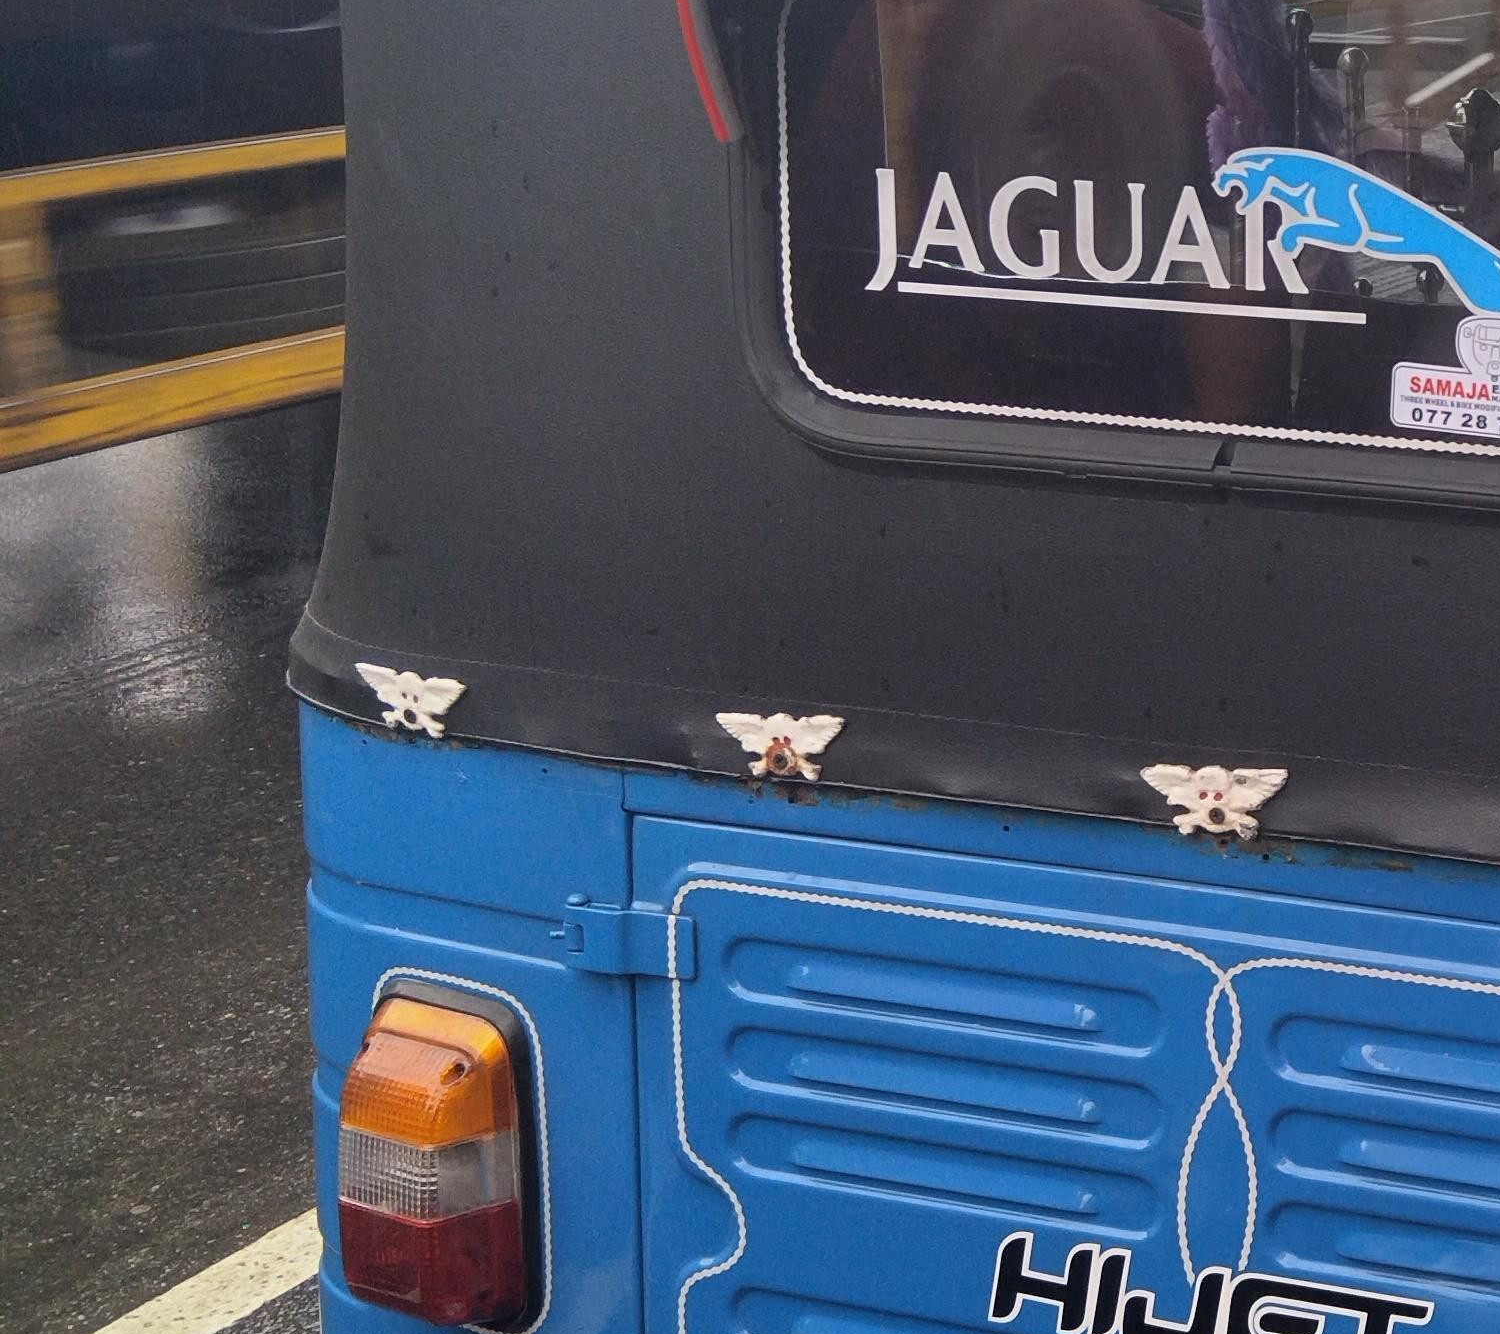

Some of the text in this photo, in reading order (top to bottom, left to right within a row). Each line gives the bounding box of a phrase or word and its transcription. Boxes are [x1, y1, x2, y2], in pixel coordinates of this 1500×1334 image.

[864, 168, 1310, 295] JAGUAR
[1410, 376, 1491, 401] SAMAJA
[1400, 395, 1423, 404] THREE
[1425, 397, 1450, 407] WHEEL
[1456, 401, 1473, 409] BIKE
[1412, 407, 1452, 425] 077
[1462, 413, 1487, 429] 28
